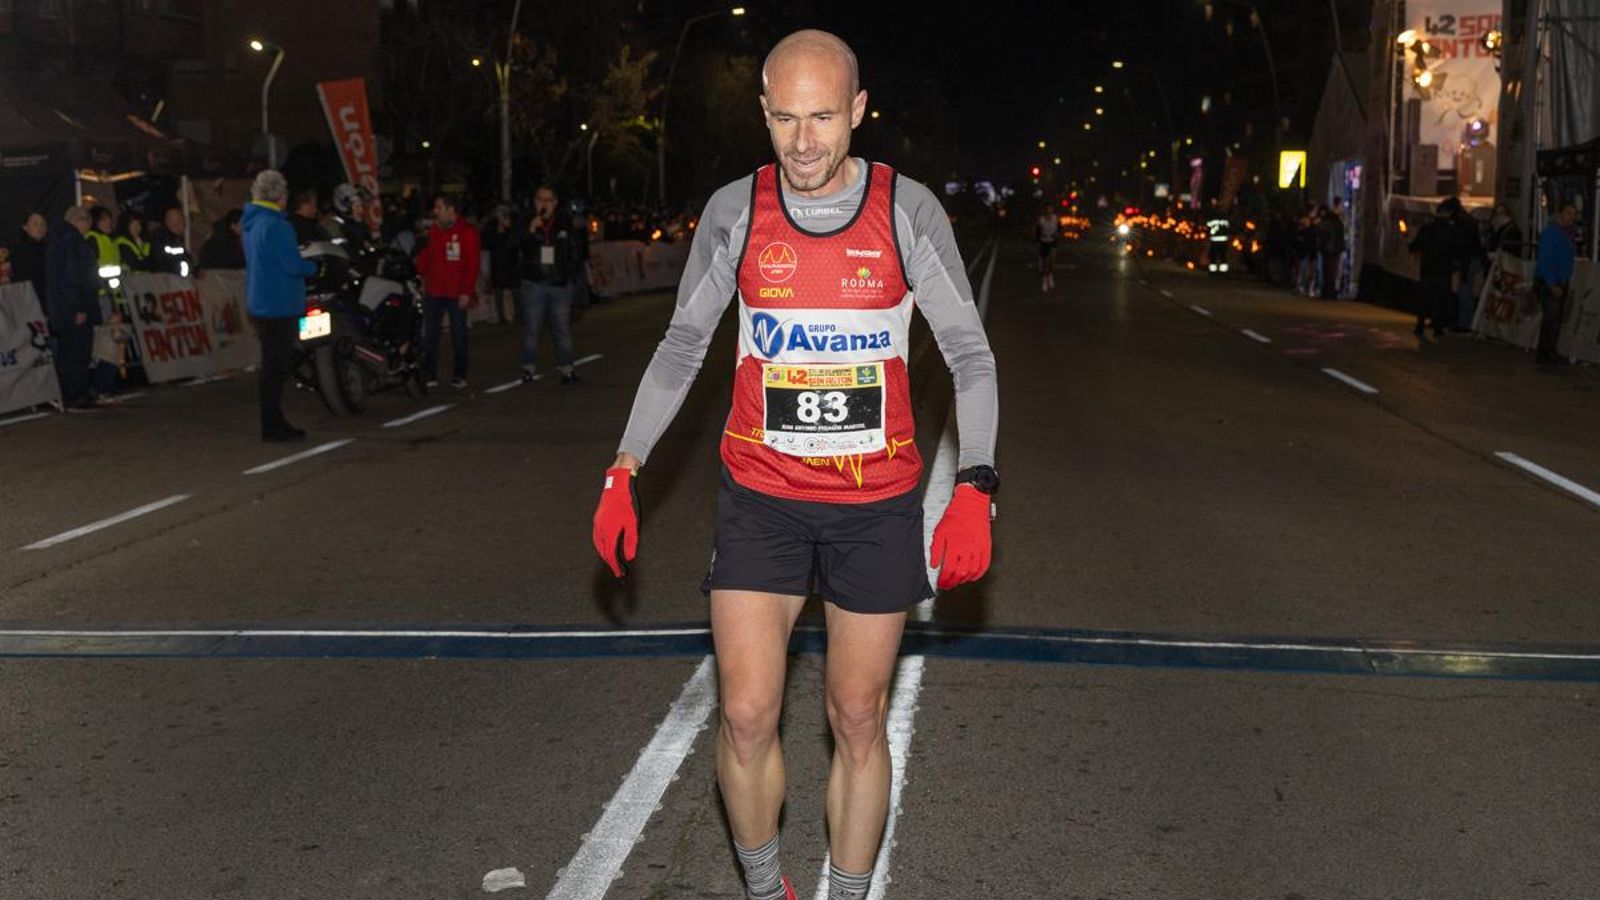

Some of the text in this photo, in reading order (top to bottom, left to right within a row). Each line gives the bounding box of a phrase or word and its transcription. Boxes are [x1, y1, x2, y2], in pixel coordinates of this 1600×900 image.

[1425, 15, 1456, 35] 42
[759, 287, 794, 298] GIOVA
[841, 278, 884, 289] RODMA
[160, 289, 204, 325] SAN
[786, 324, 892, 352] Avanza
[808, 324, 836, 333] GRUPO
[143, 325, 212, 363] ANTON
[787, 369, 808, 385] 42
[797, 391, 849, 423] 83
